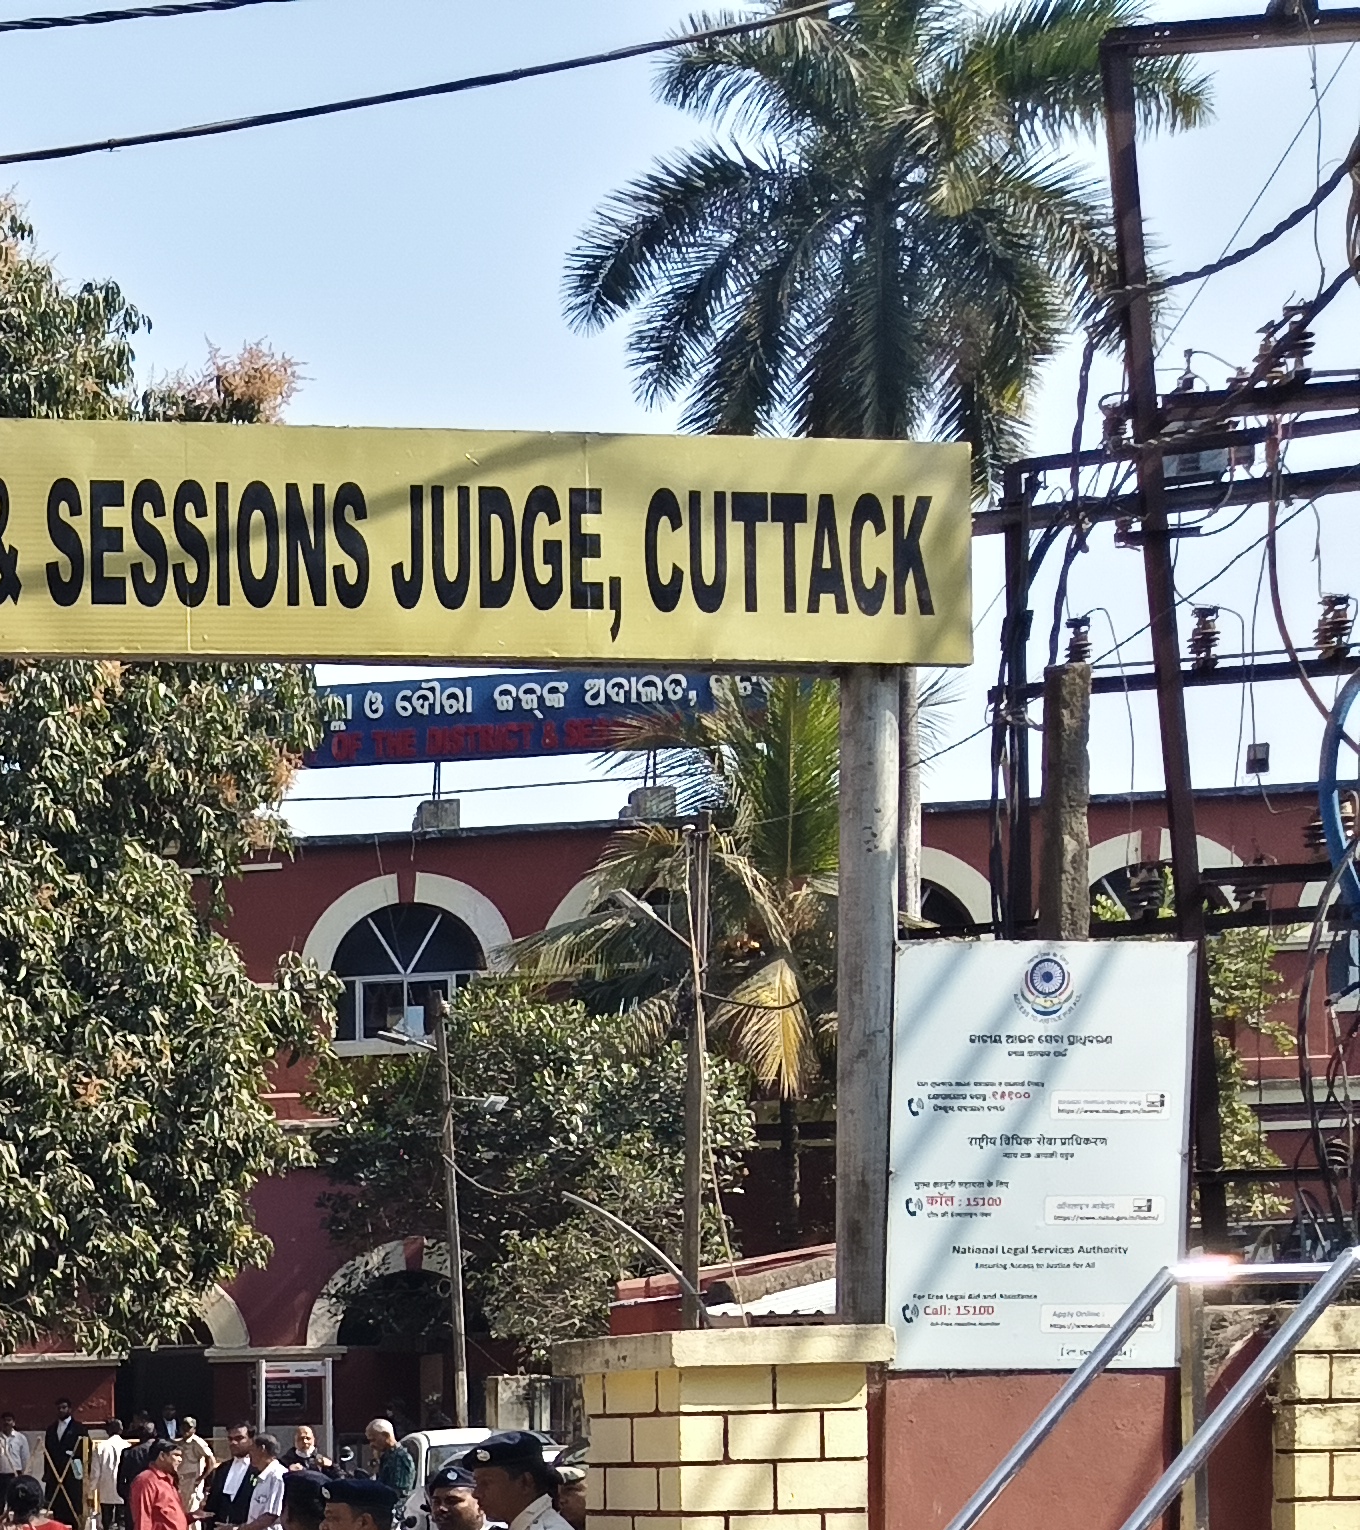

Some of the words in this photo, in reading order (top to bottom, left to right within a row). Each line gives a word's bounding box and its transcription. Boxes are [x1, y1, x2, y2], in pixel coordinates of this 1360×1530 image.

[45, 476, 370, 608] SESSIONS
[391, 483, 622, 643] JUDGE,
[644, 488, 935, 618] CUTTACK
[395, 680, 473, 717] ଦୌରା
[331, 732, 363, 761] OF
[371, 727, 417, 759] THE
[426, 722, 534, 757] DISTRICT
[966, 1197, 1002, 1207] 15100
[952, 1245, 999, 1254] National
[1002, 1245, 1029, 1256] Legal
[1031, 1245, 1074, 1254] Services
[1077, 1245, 1129, 1256] Authority
[924, 1305, 951, 1316] Call:
[956, 1305, 995, 1315] 15100
